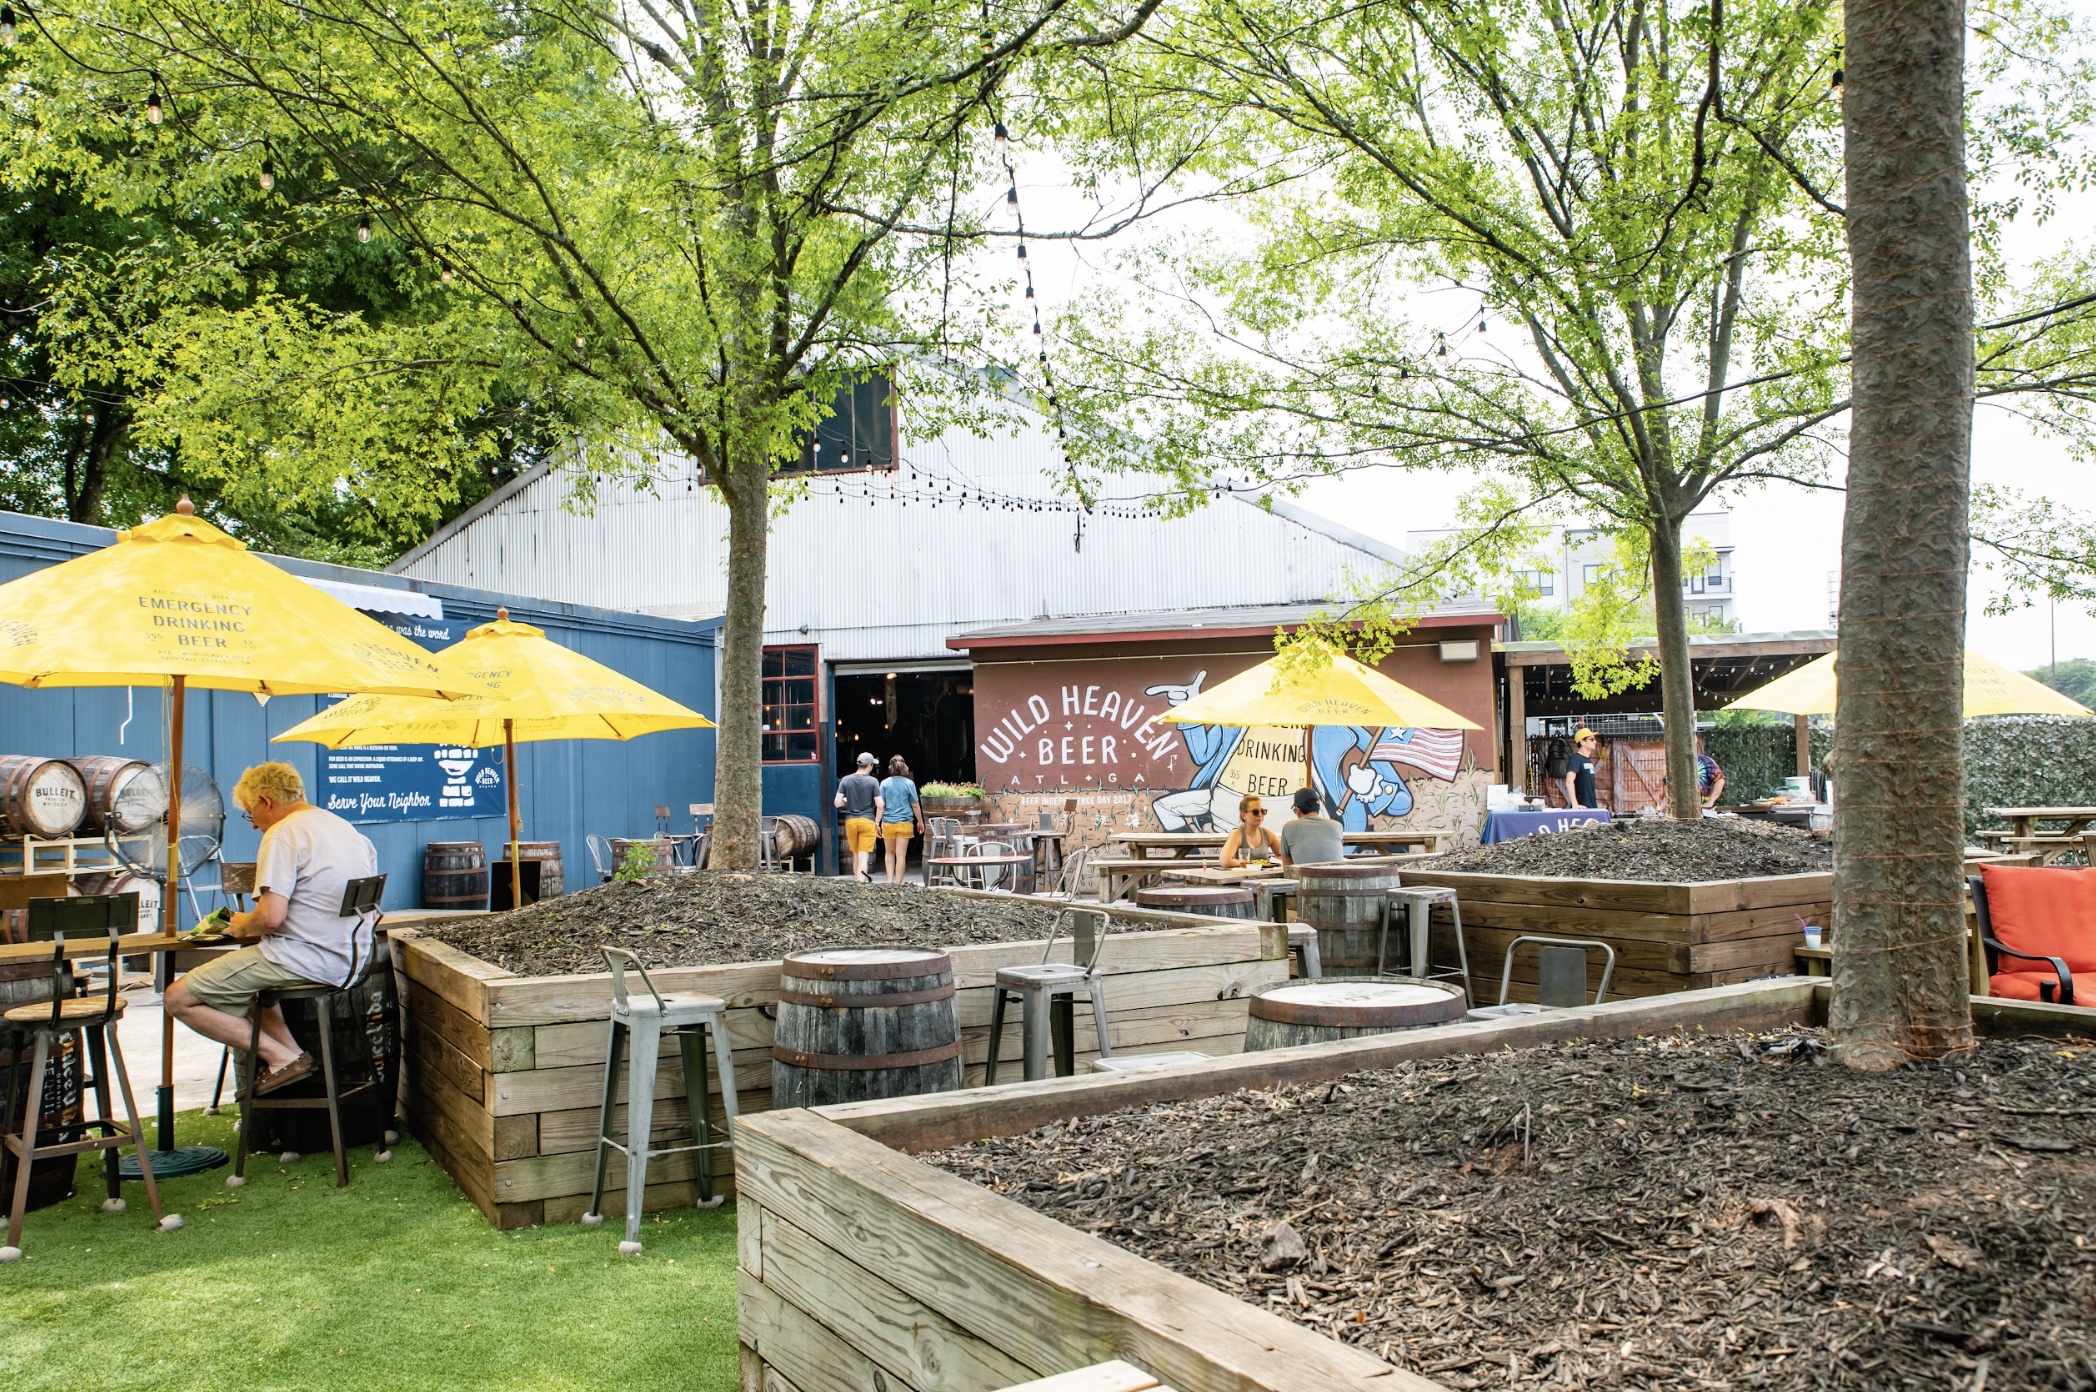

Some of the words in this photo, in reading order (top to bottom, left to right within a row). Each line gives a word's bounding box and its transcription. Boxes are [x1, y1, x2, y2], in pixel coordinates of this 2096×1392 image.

[138, 596, 253, 616] EMERGENCY
[153, 615, 245, 633] DRINKING
[396, 625, 412, 637] was
[414, 624, 427, 638] the
[428, 628, 450, 641] word.
[178, 634, 228, 649] BEER
[979, 694, 1051, 764] WILD
[1061, 685, 1180, 761] HEAVEN
[1038, 734, 1119, 766] BEER
[1238, 738, 1306, 763] DRINKING
[1010, 774, 1069, 786] ATL
[1107, 772, 1145, 783] GA
[1247, 773, 1288, 797] BEER
[35, 788, 76, 799] BULLEIT
[328, 793, 358, 810] Serve
[360, 792, 386, 815] Your
[388, 791, 432, 815] Neighbor
[1021, 796, 1039, 806] BEER
[1041, 795, 1095, 806] INDEPEENCE
[1097, 795, 1112, 805] DAY
[1113, 794, 1132, 805] 2017
